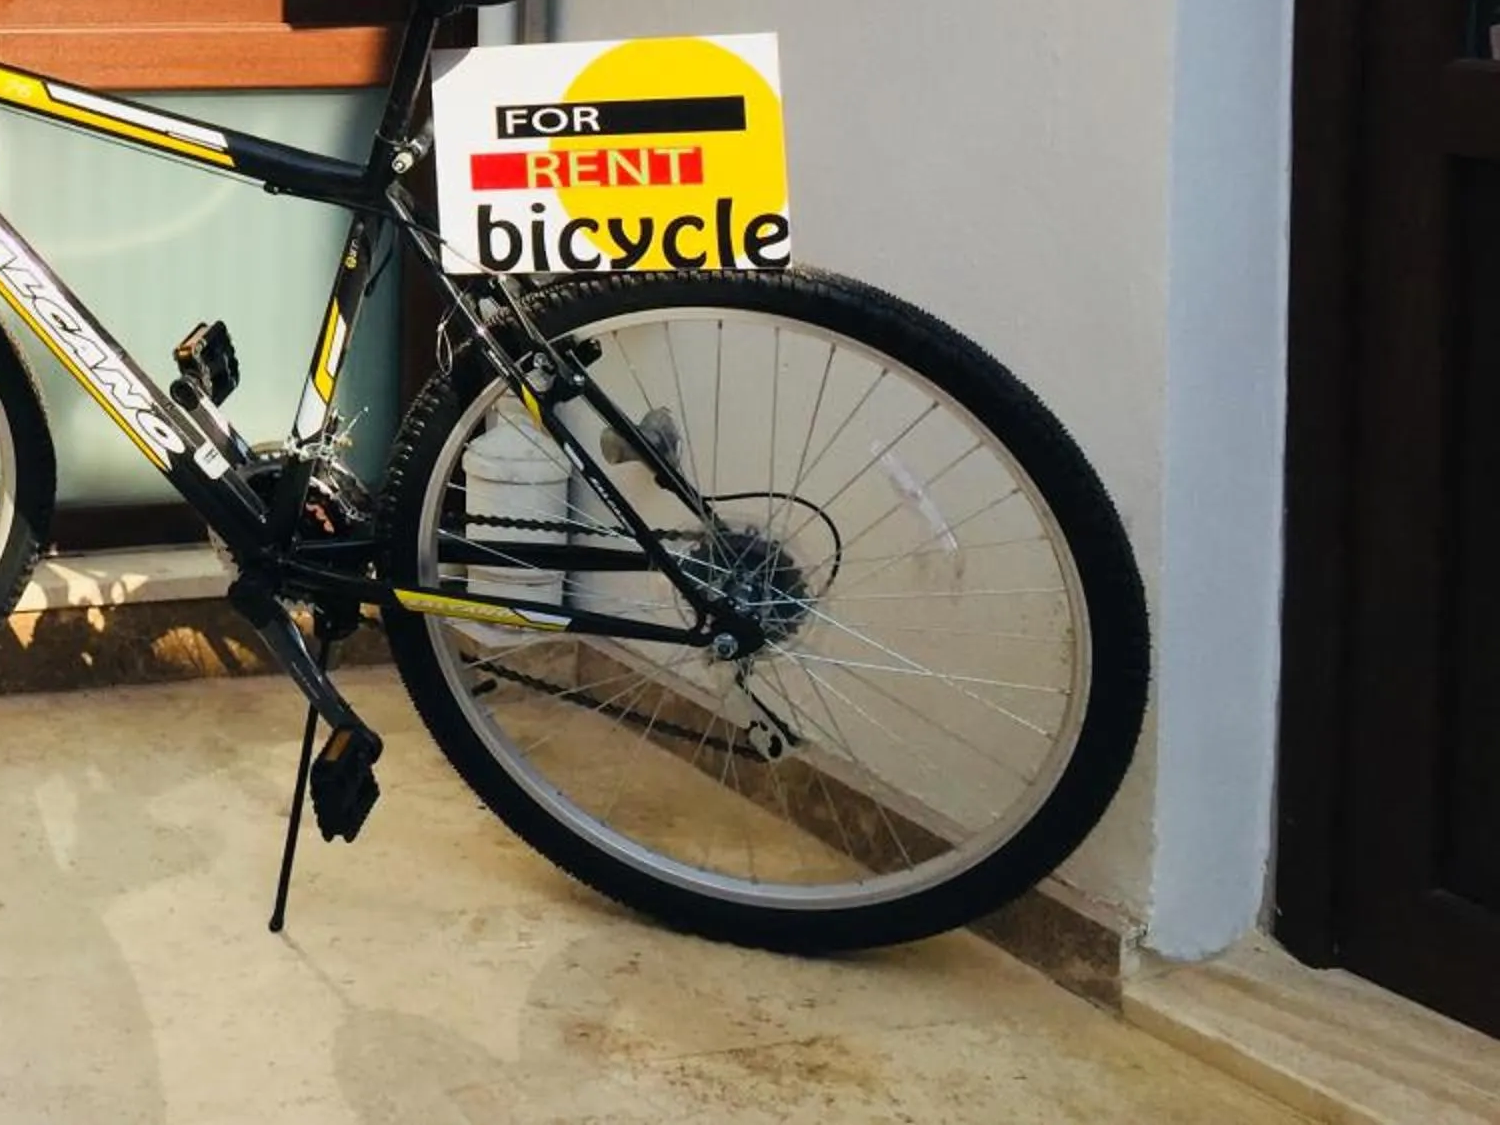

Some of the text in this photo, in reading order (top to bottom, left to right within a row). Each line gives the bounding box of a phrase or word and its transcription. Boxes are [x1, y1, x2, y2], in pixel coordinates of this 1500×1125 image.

[505, 106, 600, 134] FOR
[525, 148, 694, 188] RENT
[477, 198, 791, 270] bicycle
